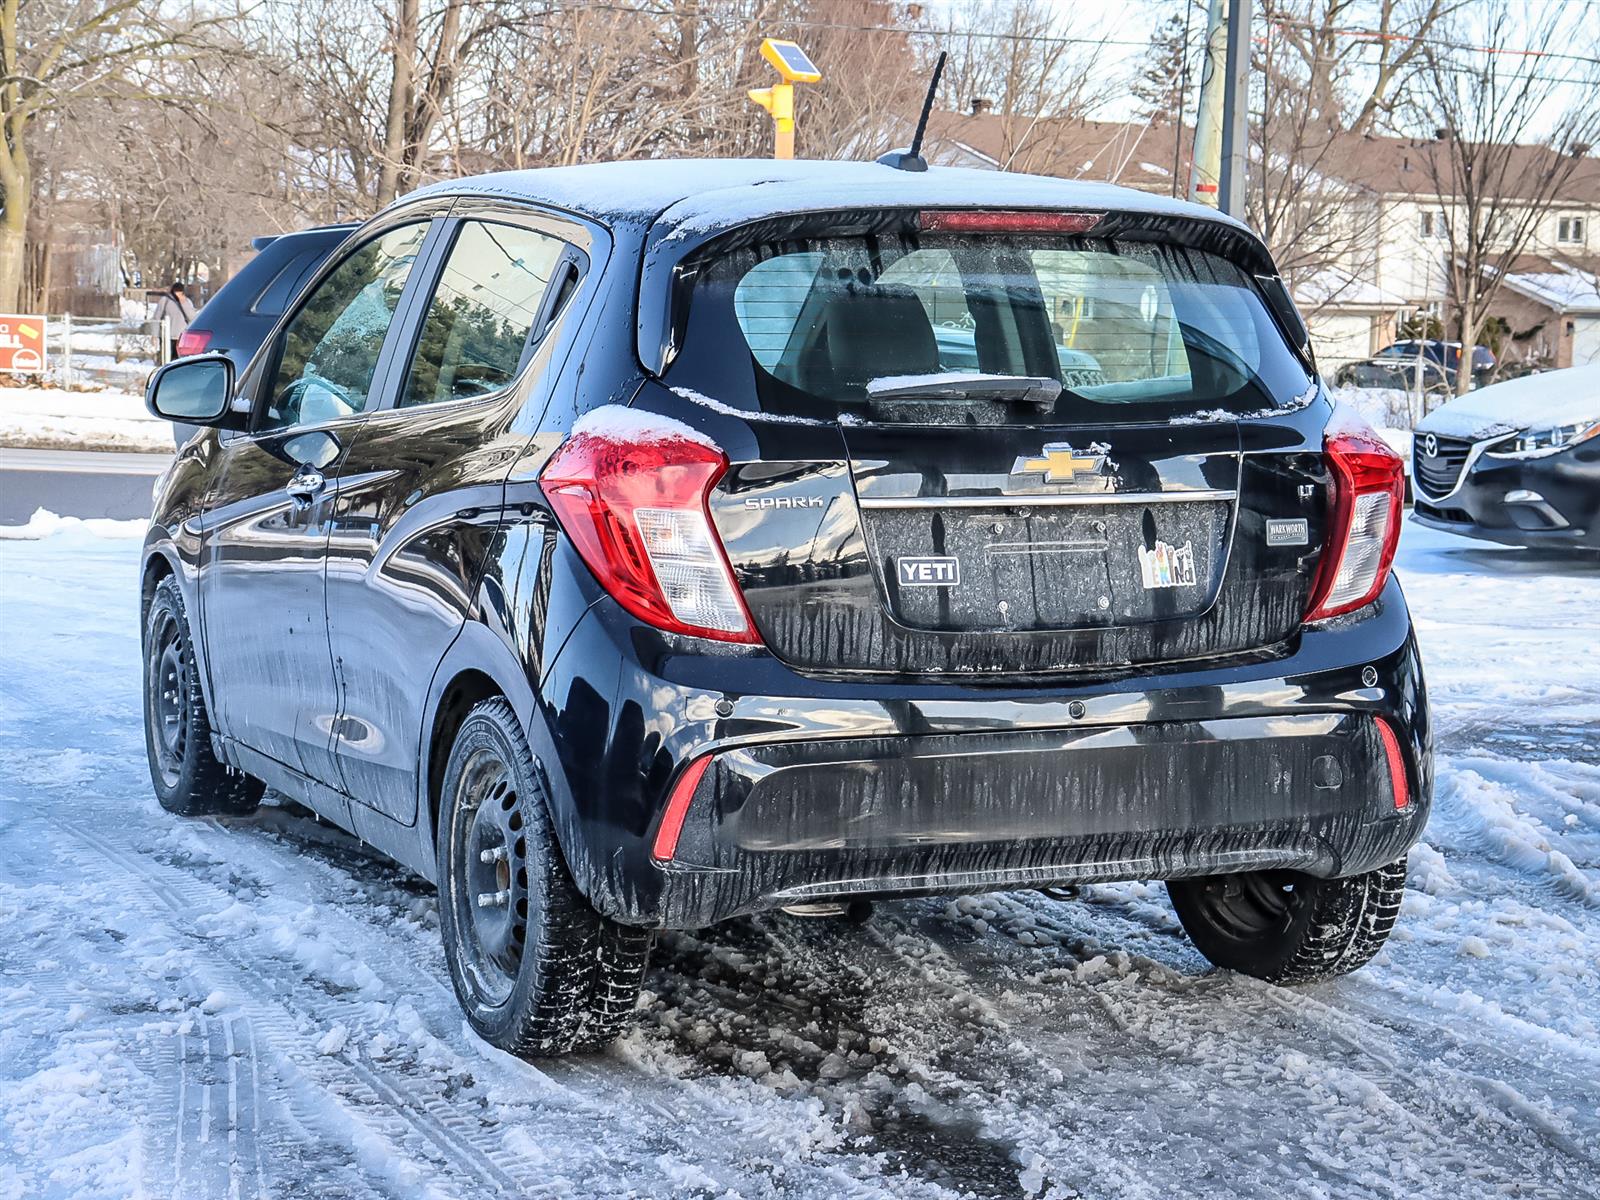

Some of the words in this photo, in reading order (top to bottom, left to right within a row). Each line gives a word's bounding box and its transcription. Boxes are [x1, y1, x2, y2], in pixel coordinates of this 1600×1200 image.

[1298, 484, 1314, 497] LT
[745, 496, 823, 510] SPARK
[902, 563, 955, 580] YETI
